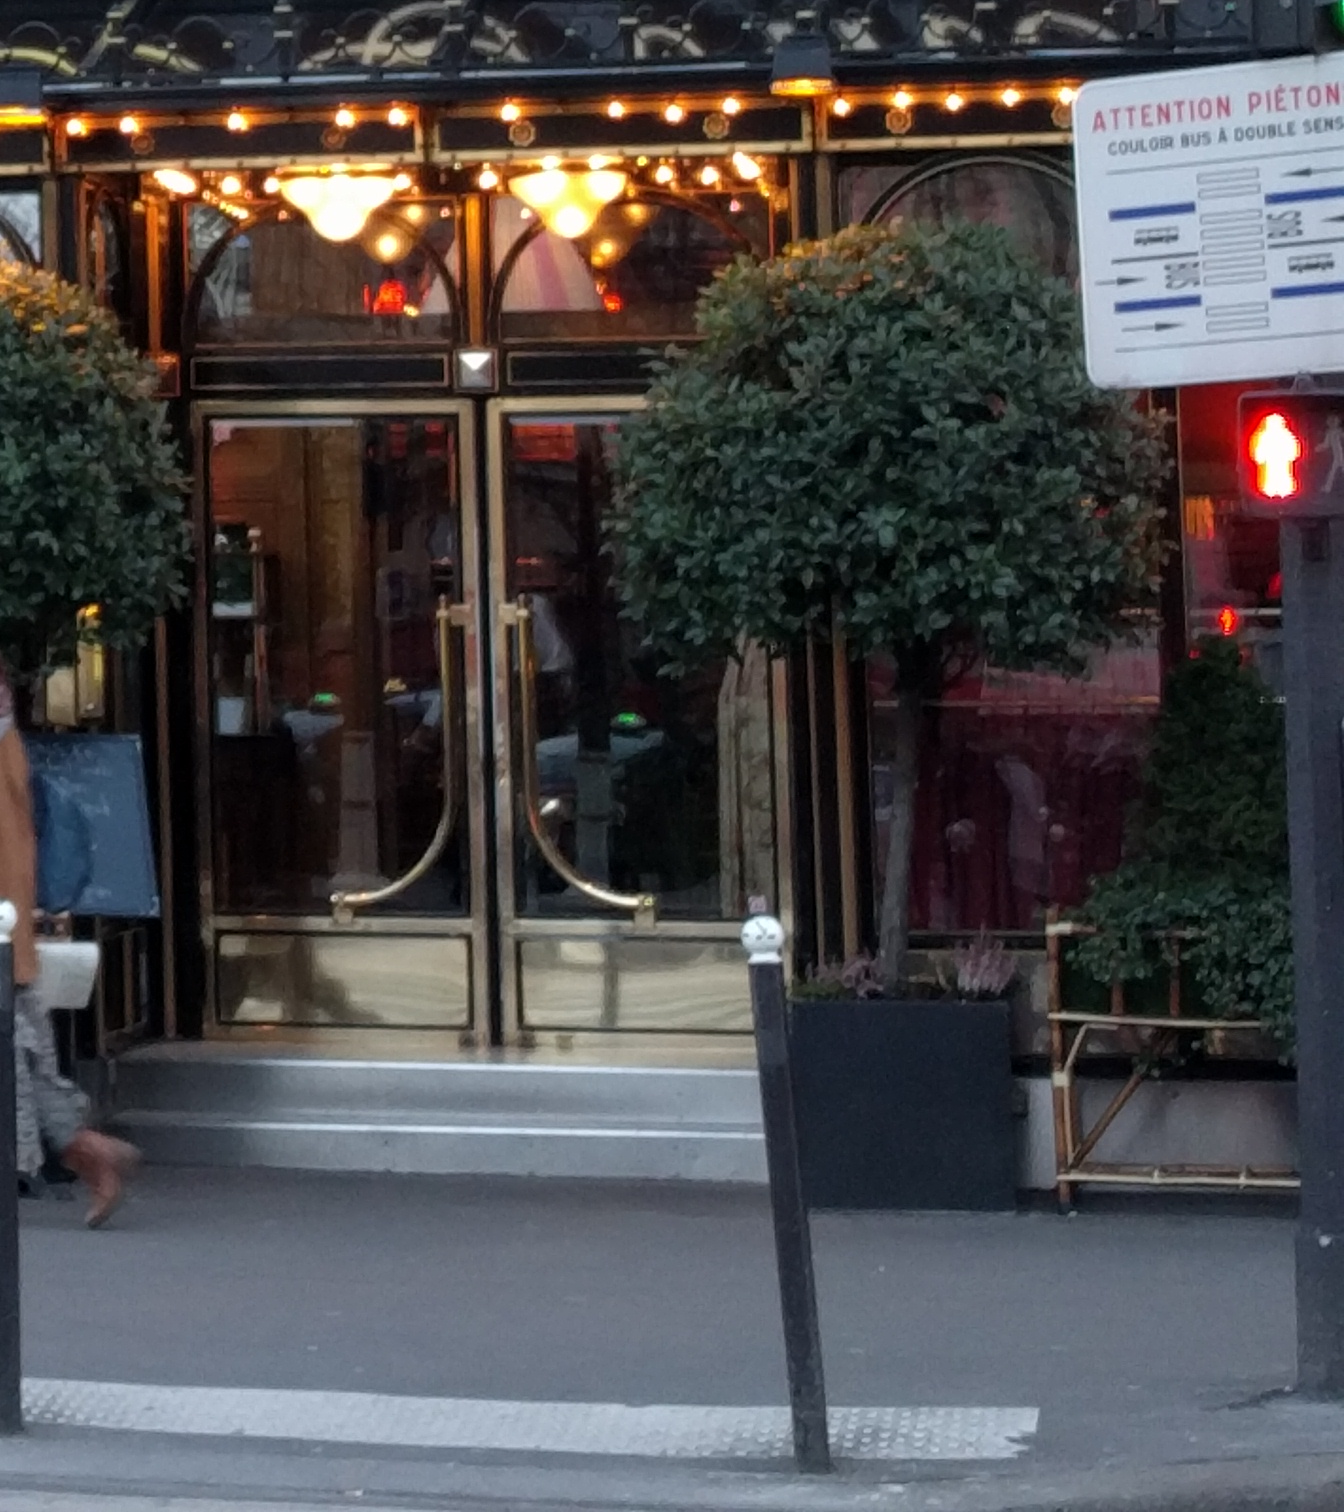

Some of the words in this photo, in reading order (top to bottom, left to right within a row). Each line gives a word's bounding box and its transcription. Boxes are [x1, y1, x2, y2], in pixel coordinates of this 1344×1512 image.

[1091, 94, 1232, 133] ATTENTION
[1247, 81, 1344, 116] PIÉTON
[1107, 134, 1176, 157] COULOIR
[1180, 130, 1212, 149] BUS
[1233, 119, 1297, 143] DOUBLE
[1302, 115, 1344, 136] SENS
